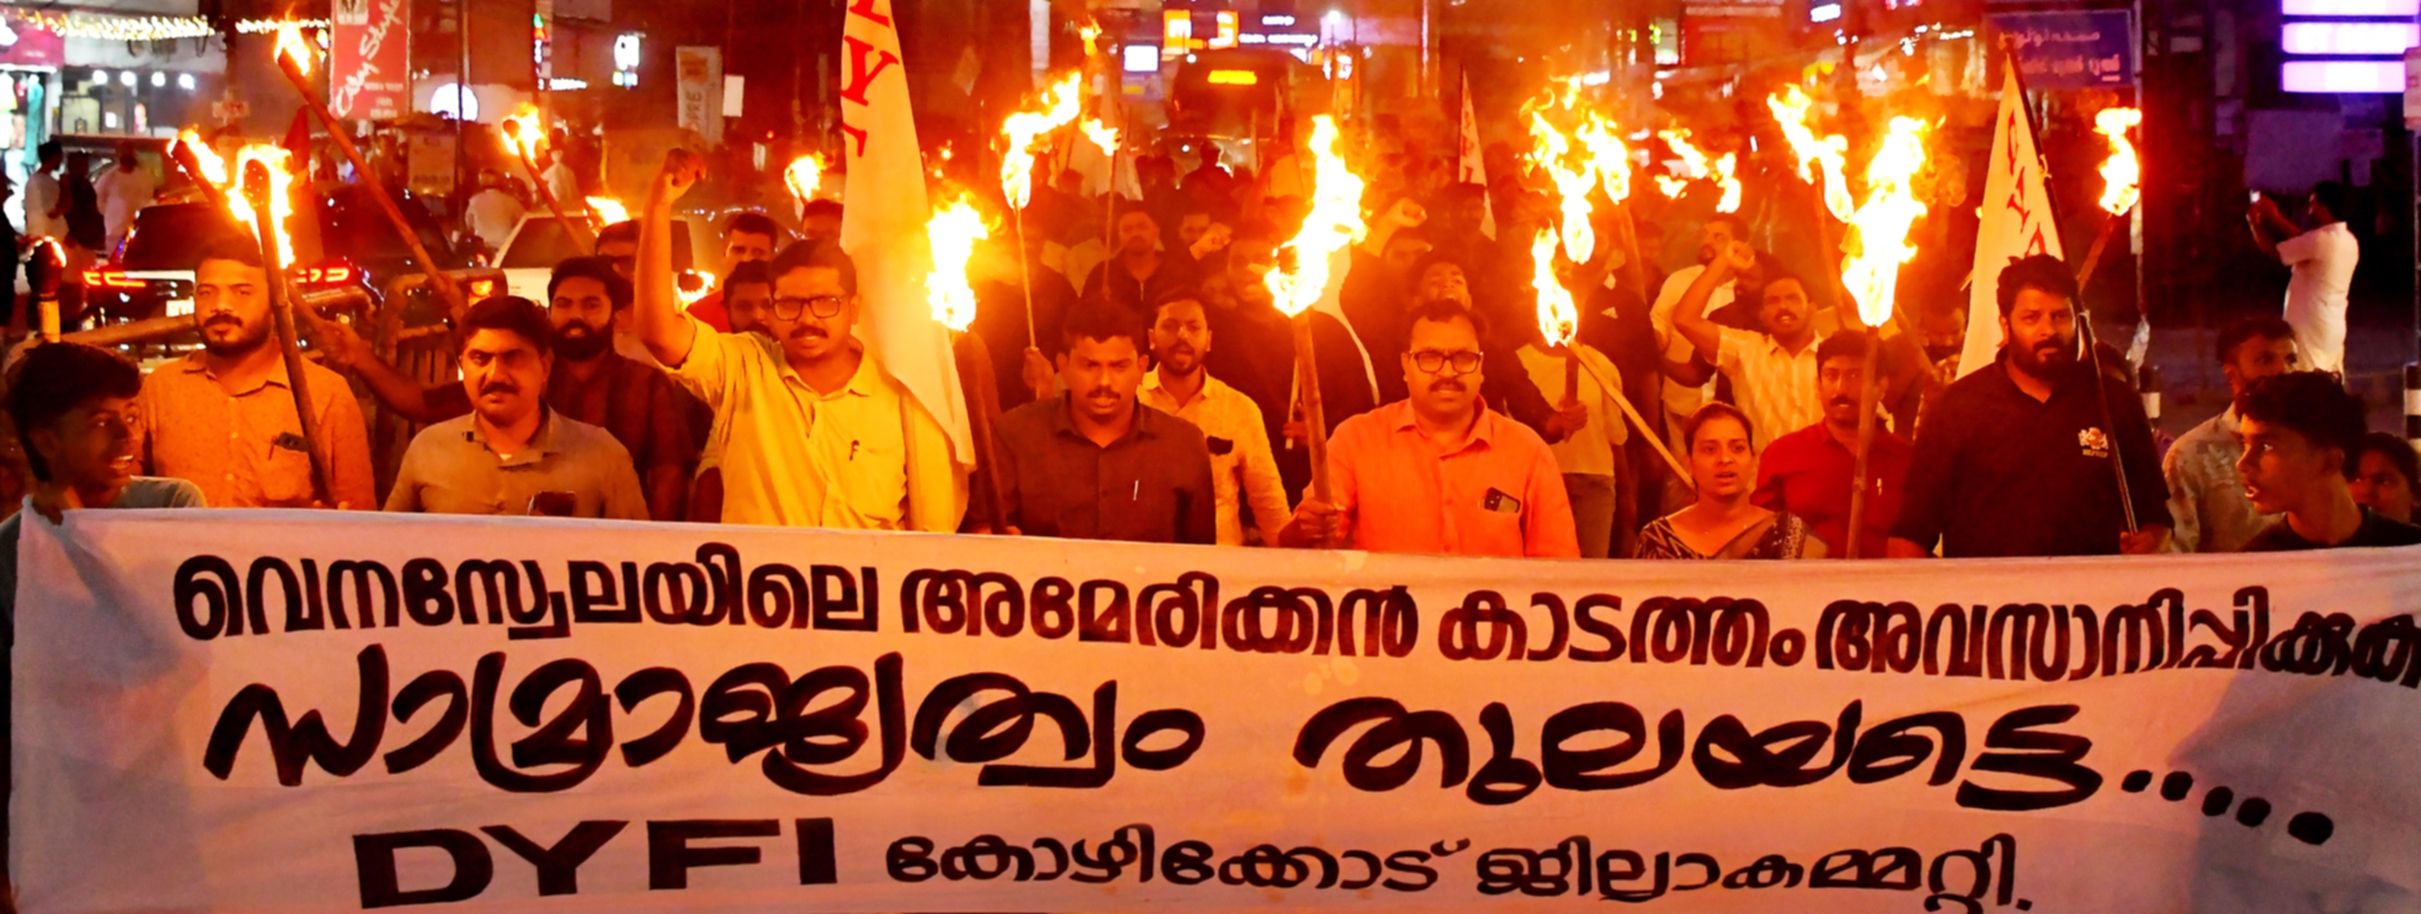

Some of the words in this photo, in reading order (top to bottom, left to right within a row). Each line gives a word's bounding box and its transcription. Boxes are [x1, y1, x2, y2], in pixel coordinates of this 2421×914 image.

[173, 543, 878, 640] വെനസ്വേലയിലെ
[901, 569, 1418, 657] അമേരിക്കൻ
[1439, 591, 1806, 681] കാടത്തം
[203, 643, 1206, 796] സാമ്രാജ്യത്വം
[352, 817, 838, 909] DYFI
[885, 823, 1471, 893] കോഴിക്കോട്
